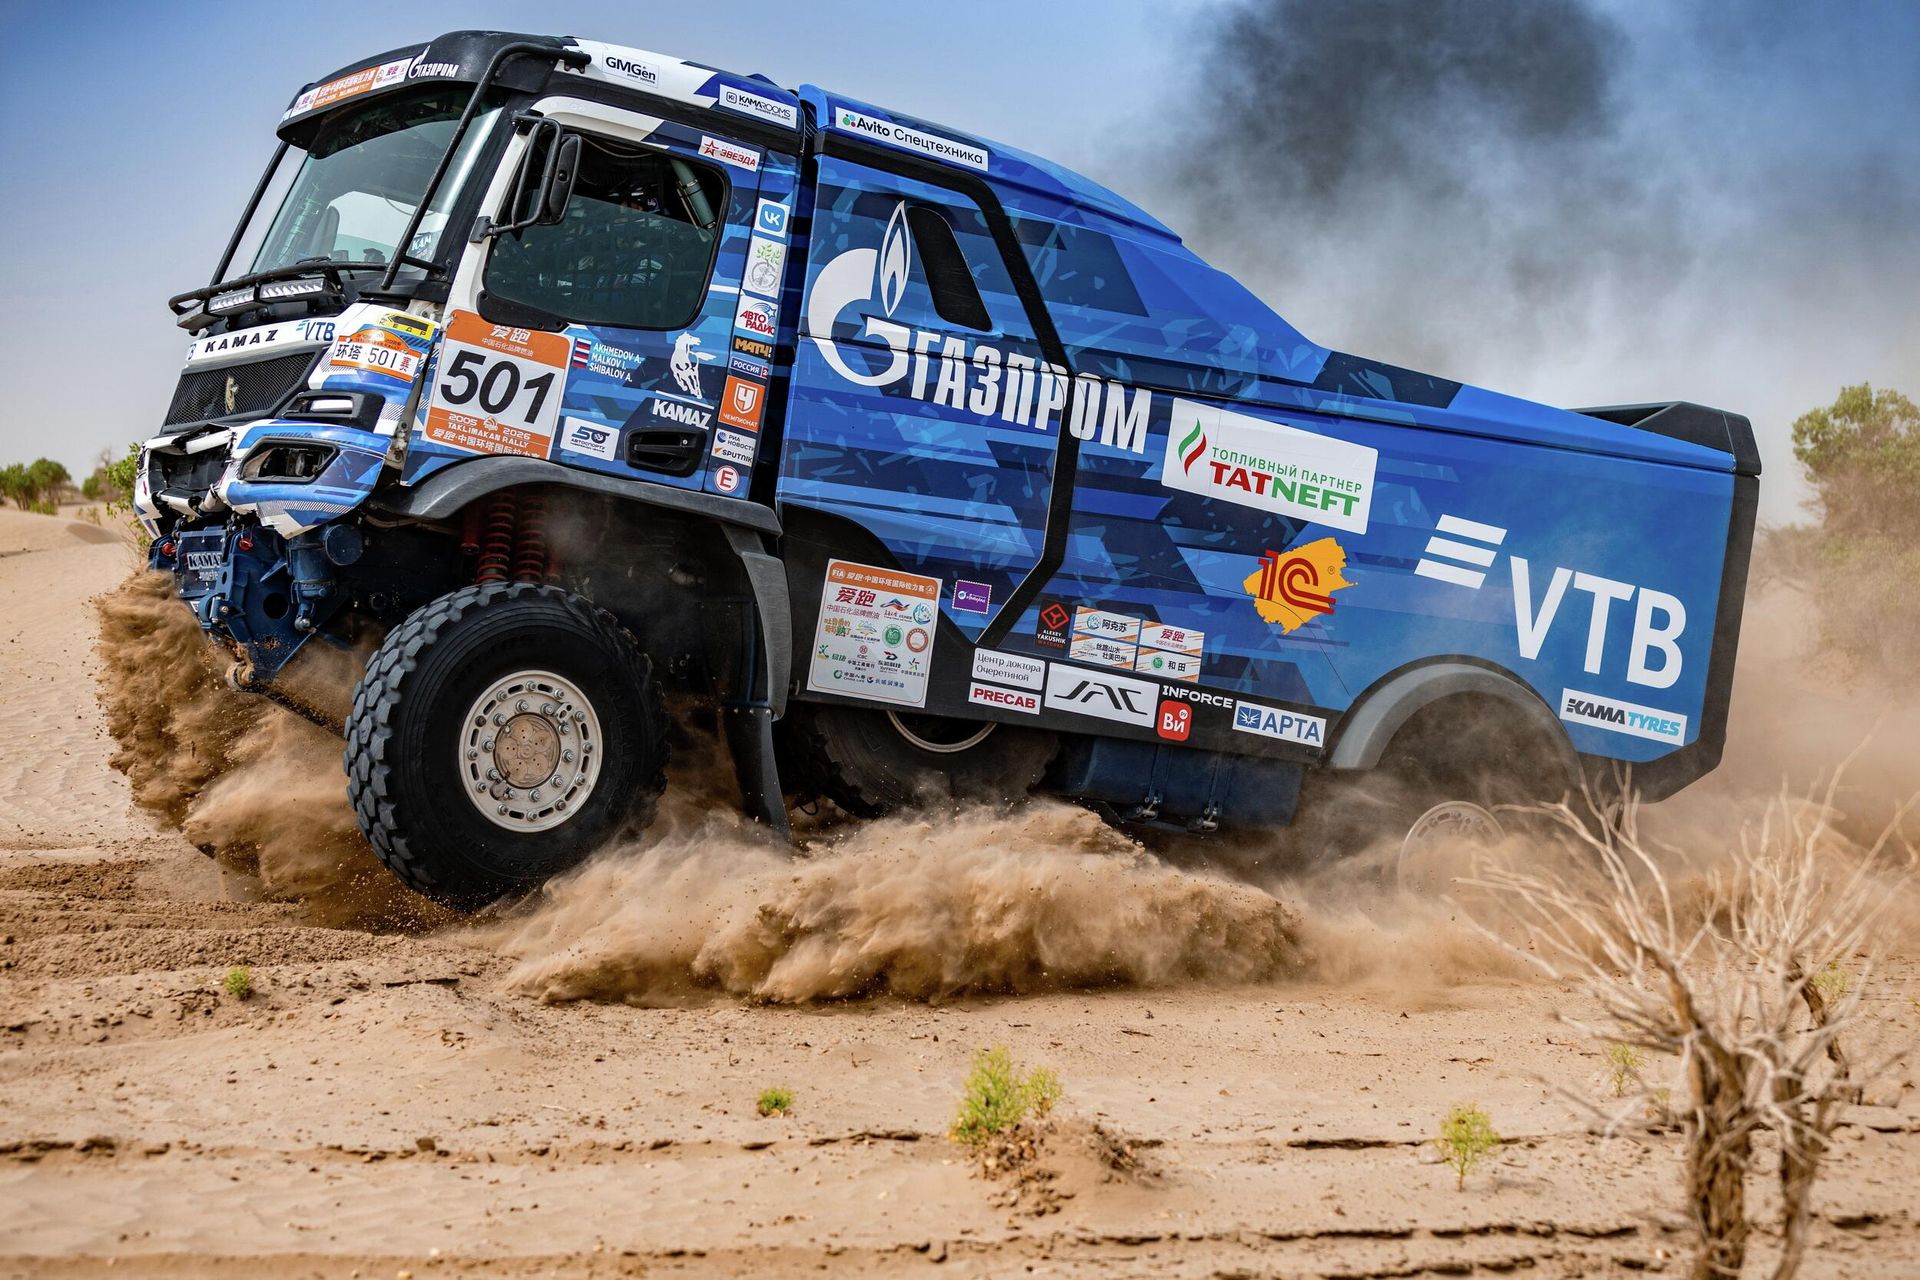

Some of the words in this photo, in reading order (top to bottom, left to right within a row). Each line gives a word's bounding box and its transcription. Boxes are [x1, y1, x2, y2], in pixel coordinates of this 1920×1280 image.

[418, 62, 460, 78] ГАЗПРОМ
[605, 56, 657, 81] GMGen
[738, 94, 791, 118] KAMAROOMS
[856, 117, 891, 137] Avito
[894, 127, 983, 165] Спецтехника
[720, 149, 756, 167] ЗВЕЗДА
[740, 310, 767, 324] АВТО
[204, 329, 279, 353] KAMAZ
[304, 320, 337, 342] VTB
[367, 349, 398, 369] 501
[591, 352, 622, 368] MALKOV
[594, 343, 635, 360] AKHMEDOV
[634, 354, 642, 364] A.
[589, 363, 626, 380] SHIBALOV
[626, 374, 633, 383] A.
[733, 359, 760, 374] РОССИЯ
[440, 349, 556, 425] 501
[911, 330, 1152, 455] ГАЗПРОМ
[652, 398, 712, 431] KAMAZ
[722, 412, 759, 428] ЧЕМПИОНАТ
[448, 413, 478, 426] 2005
[503, 427, 532, 440] 2026
[503, 436, 529, 449] RALLY
[727, 439, 755, 452] НОВОСТИ
[728, 434, 741, 443] РИА
[722, 449, 753, 463] SPUTNIK
[719, 470, 734, 489] E
[1211, 446, 1298, 478] ТОПЛИВНЫЙ
[1301, 469, 1363, 494] ПАРТНЕР
[1209, 461, 1361, 517] TATNEFT
[835, 586, 877, 608] 爱跑
[1101, 618, 1128, 633] 阿克苏
[1510, 555, 1687, 690] VTB
[1161, 628, 1186, 643] 爱跑
[976, 664, 1030, 683] Очеретиной
[977, 652, 1004, 669] Центр
[1006, 657, 1042, 676] доктора
[1167, 660, 1187, 672] 和田
[973, 687, 1036, 709] PRECAB
[1053, 680, 1148, 716] JAC
[1162, 685, 1234, 709] INFORCE
[1566, 698, 1626, 725] KAMA
[1628, 711, 1681, 737] TYRES
